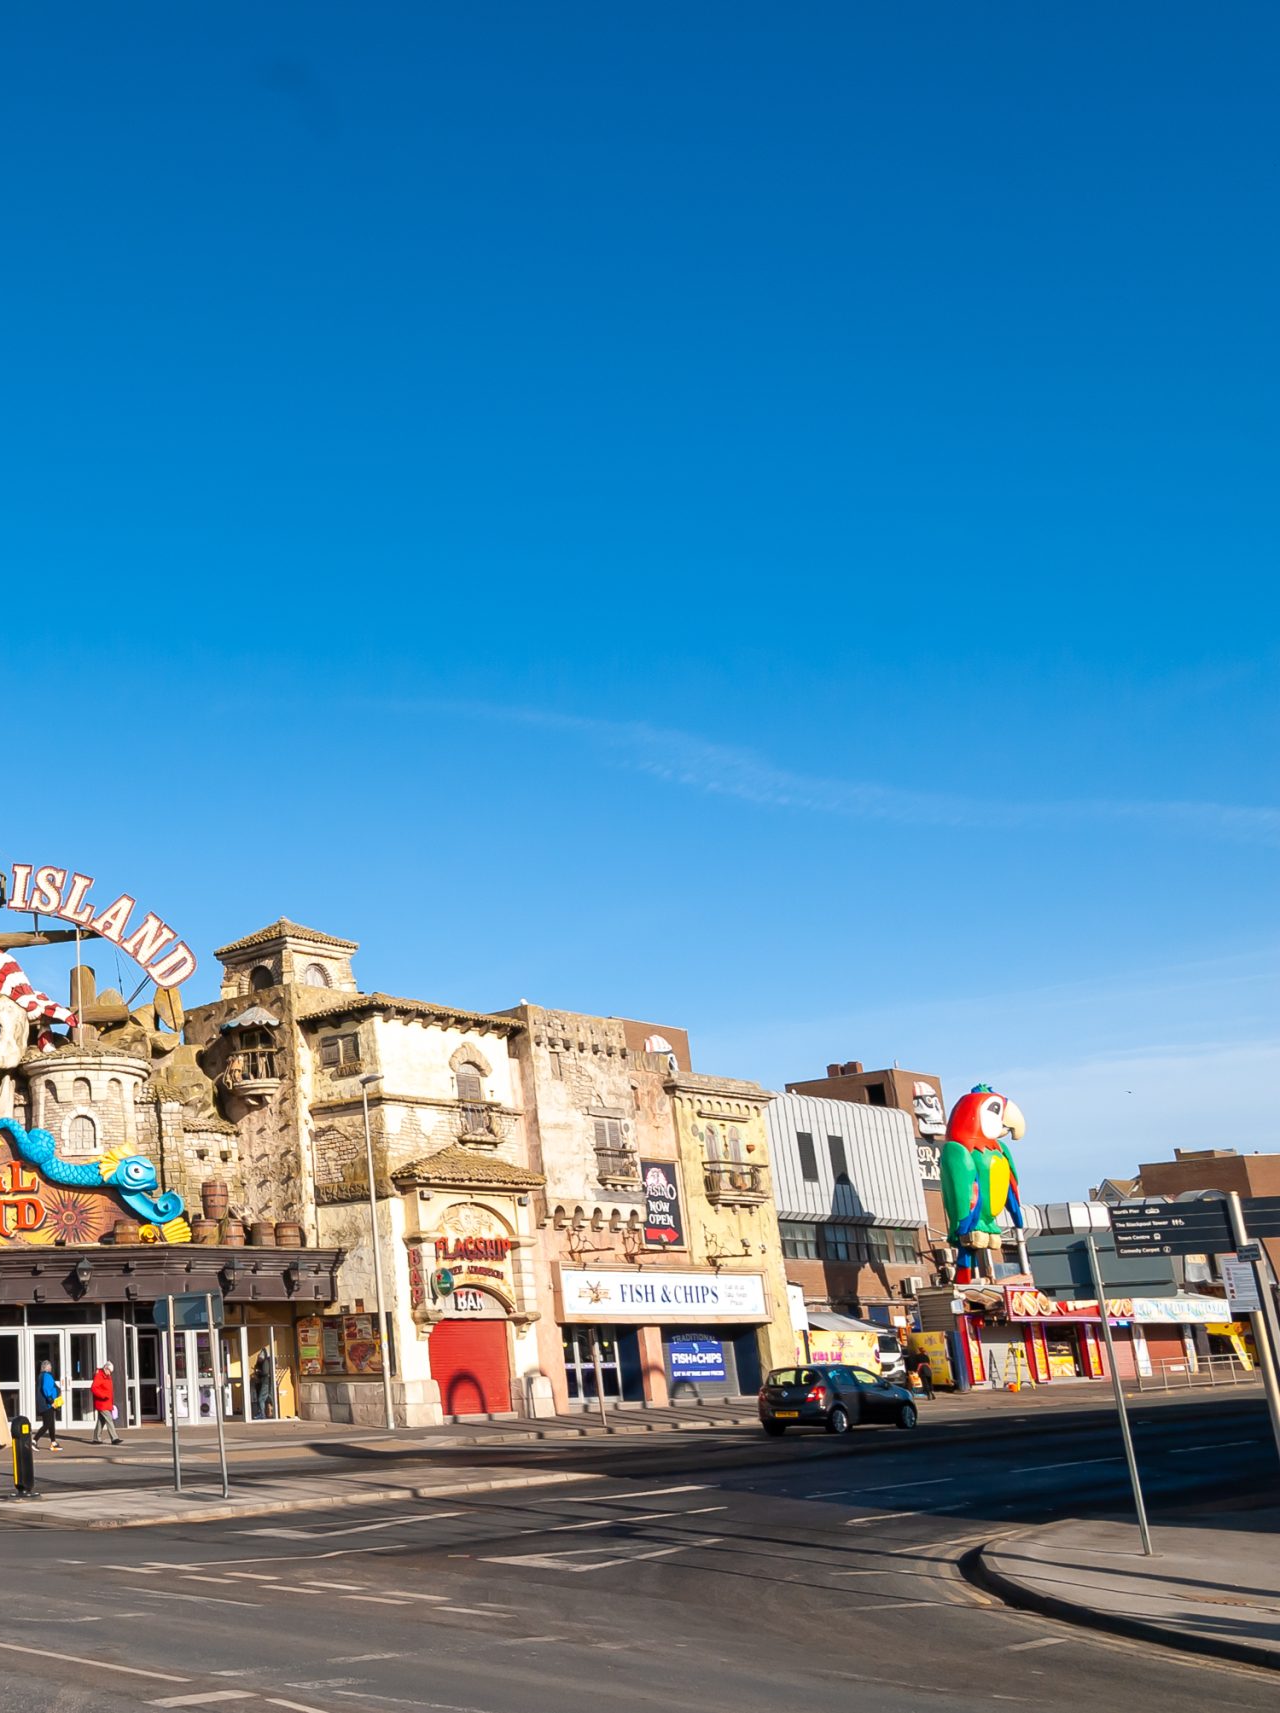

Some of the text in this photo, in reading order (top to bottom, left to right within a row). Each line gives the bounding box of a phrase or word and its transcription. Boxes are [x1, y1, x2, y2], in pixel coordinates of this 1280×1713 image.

[7, 863, 198, 990] ISLAND
[648, 1200, 670, 1213] NOW
[649, 1213, 675, 1228] OPEN
[435, 1236, 512, 1262] FLAGSHIP
[408, 1248, 424, 1306] BAR
[453, 1290, 486, 1311] BAR
[620, 1284, 655, 1303] FISH
[660, 1284, 671, 1303] &
[673, 1285, 719, 1304] CHIPS
[672, 1333, 718, 1344] TRADITIONAL
[672, 1353, 692, 1364] FISH
[697, 1353, 722, 1364] CHIPS
